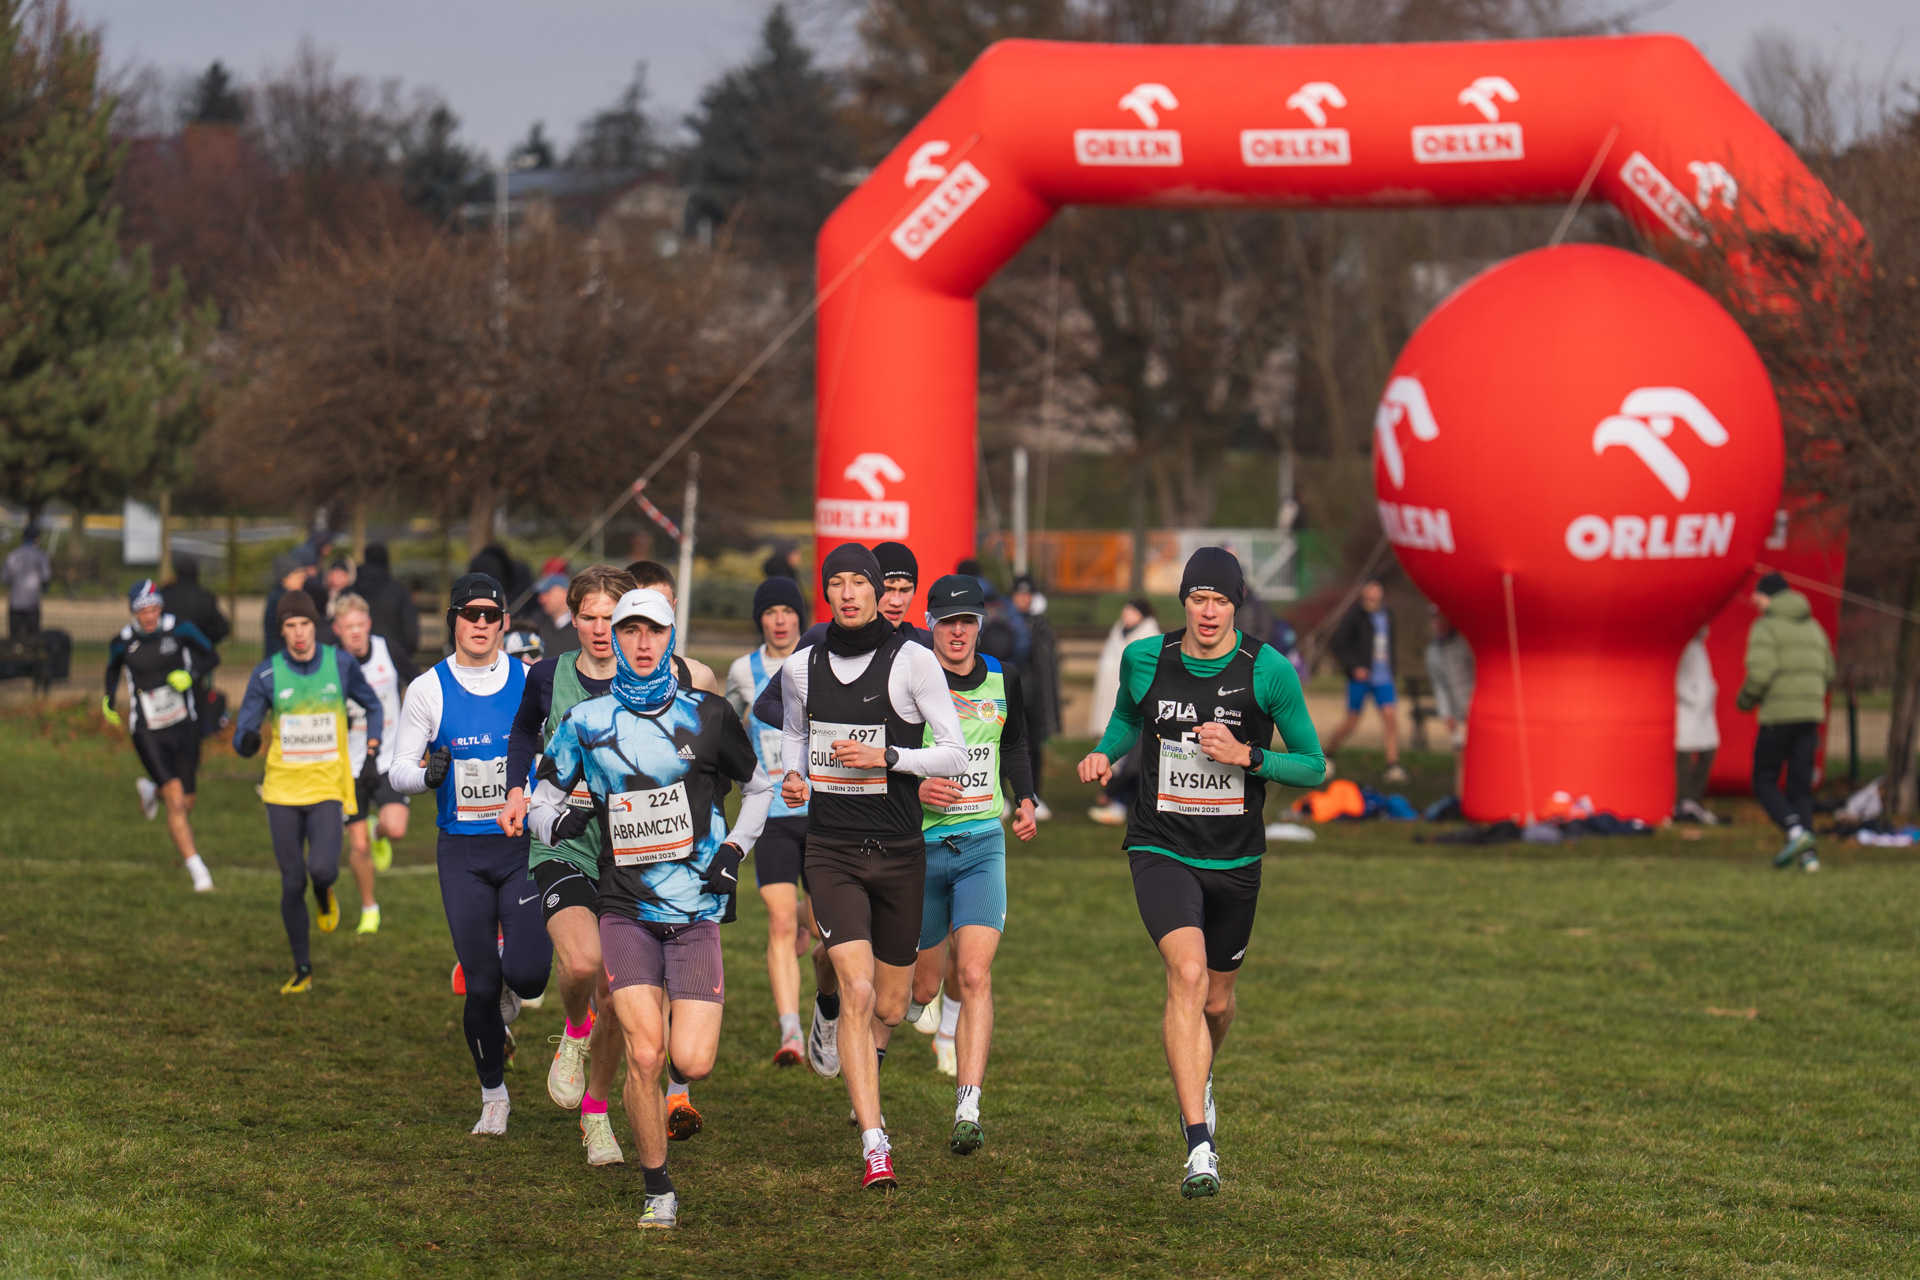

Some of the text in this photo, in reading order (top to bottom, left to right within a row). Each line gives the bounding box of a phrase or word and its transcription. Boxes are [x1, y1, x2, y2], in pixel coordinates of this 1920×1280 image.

[1085, 138, 1172, 158] ORLEN
[1251, 138, 1340, 158] ORLEN
[1422, 133, 1513, 155] ORLEN
[904, 173, 976, 247] ORLEN
[1563, 510, 1737, 562] ORLEN
[848, 728, 878, 743] 697
[1161, 750, 1188, 760] LUXMED
[1162, 743, 1184, 753] GRUPA
[827, 784, 846, 792] LUBIN
[1169, 770, 1232, 790] ŁYSIAK
[571, 798, 592, 806] LUBIN
[647, 788, 680, 808] 224
[943, 804, 963, 813] LUBIN
[1178, 805, 1200, 813] LUBIN
[613, 812, 690, 840] ABRAMCZYK
[636, 852, 677, 862] LUBIN 2025
